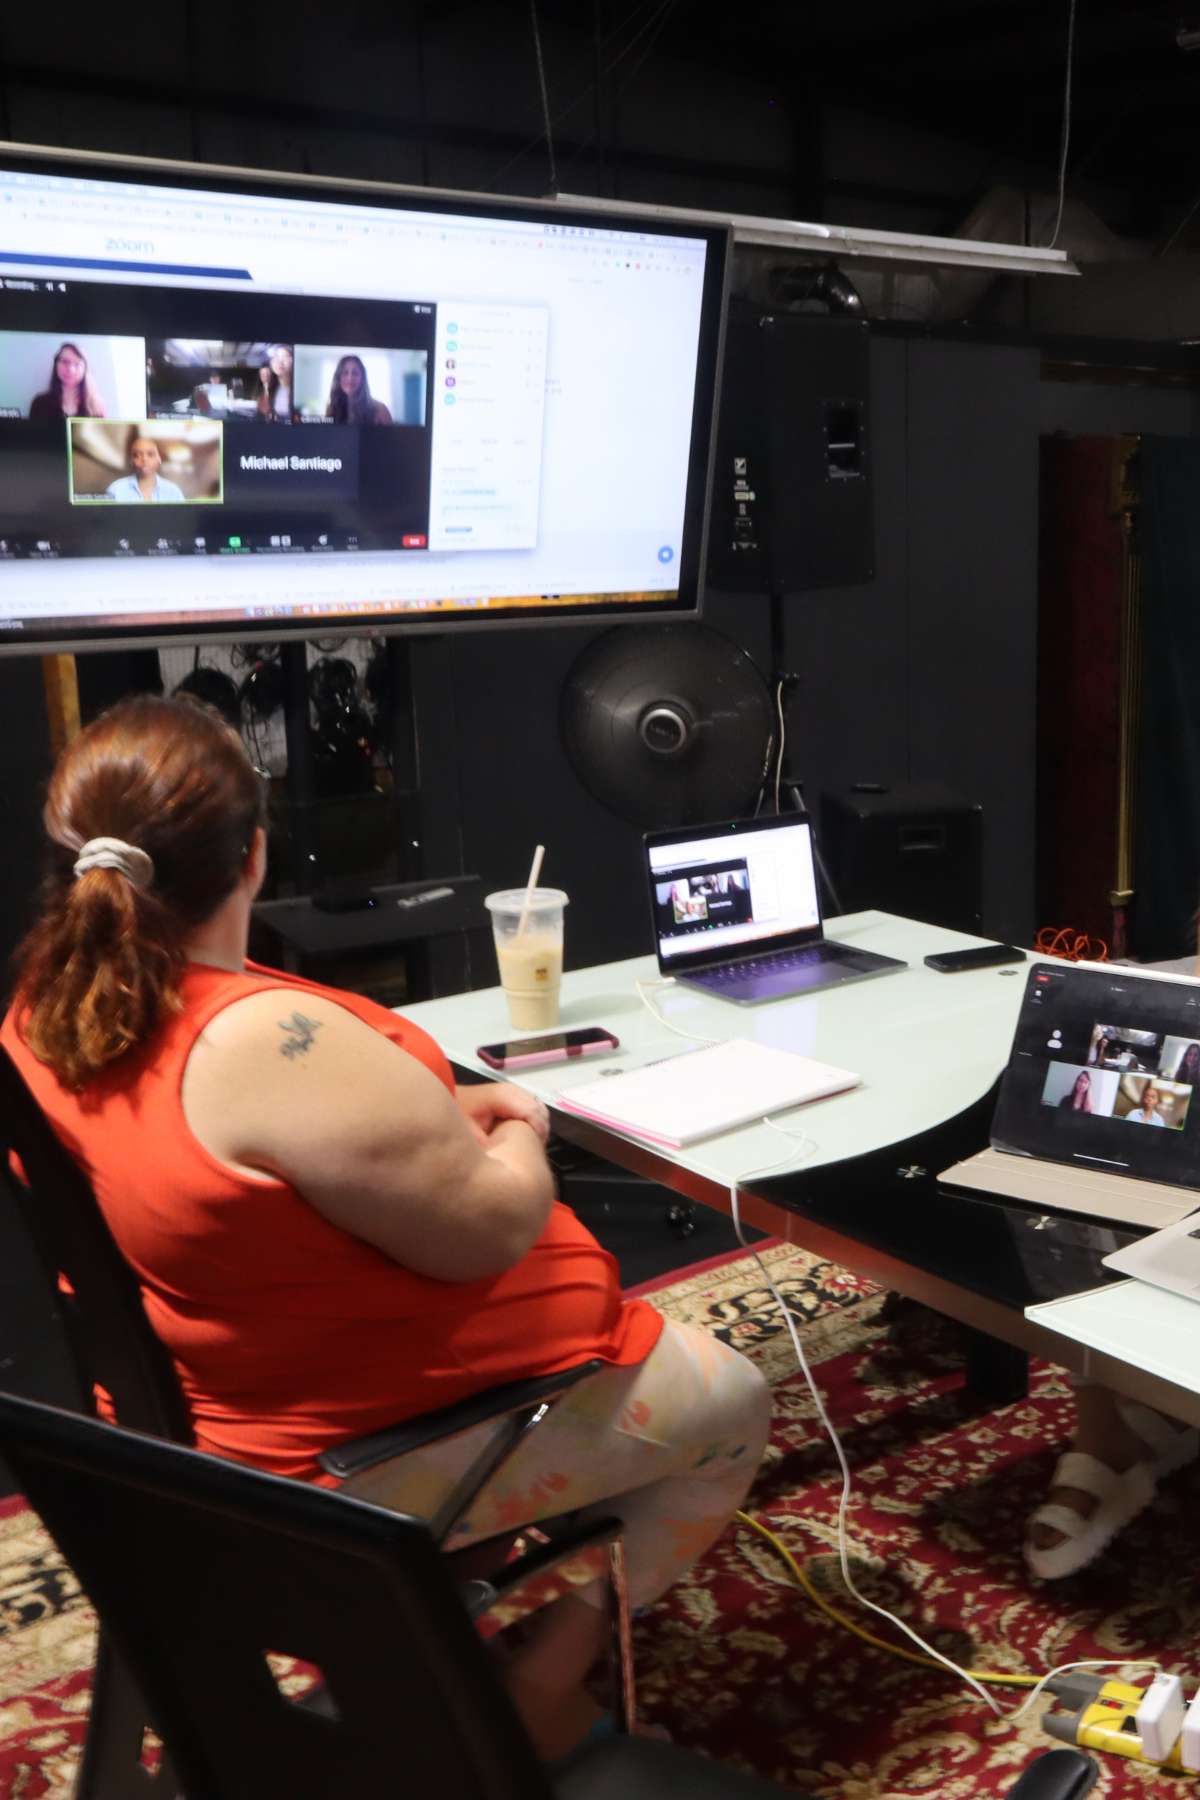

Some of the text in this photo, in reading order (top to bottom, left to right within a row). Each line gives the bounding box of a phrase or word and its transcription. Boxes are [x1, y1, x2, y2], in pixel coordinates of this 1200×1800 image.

[105, 238, 155, 254] zoom
[240, 455, 342, 473] Michael Santiago
